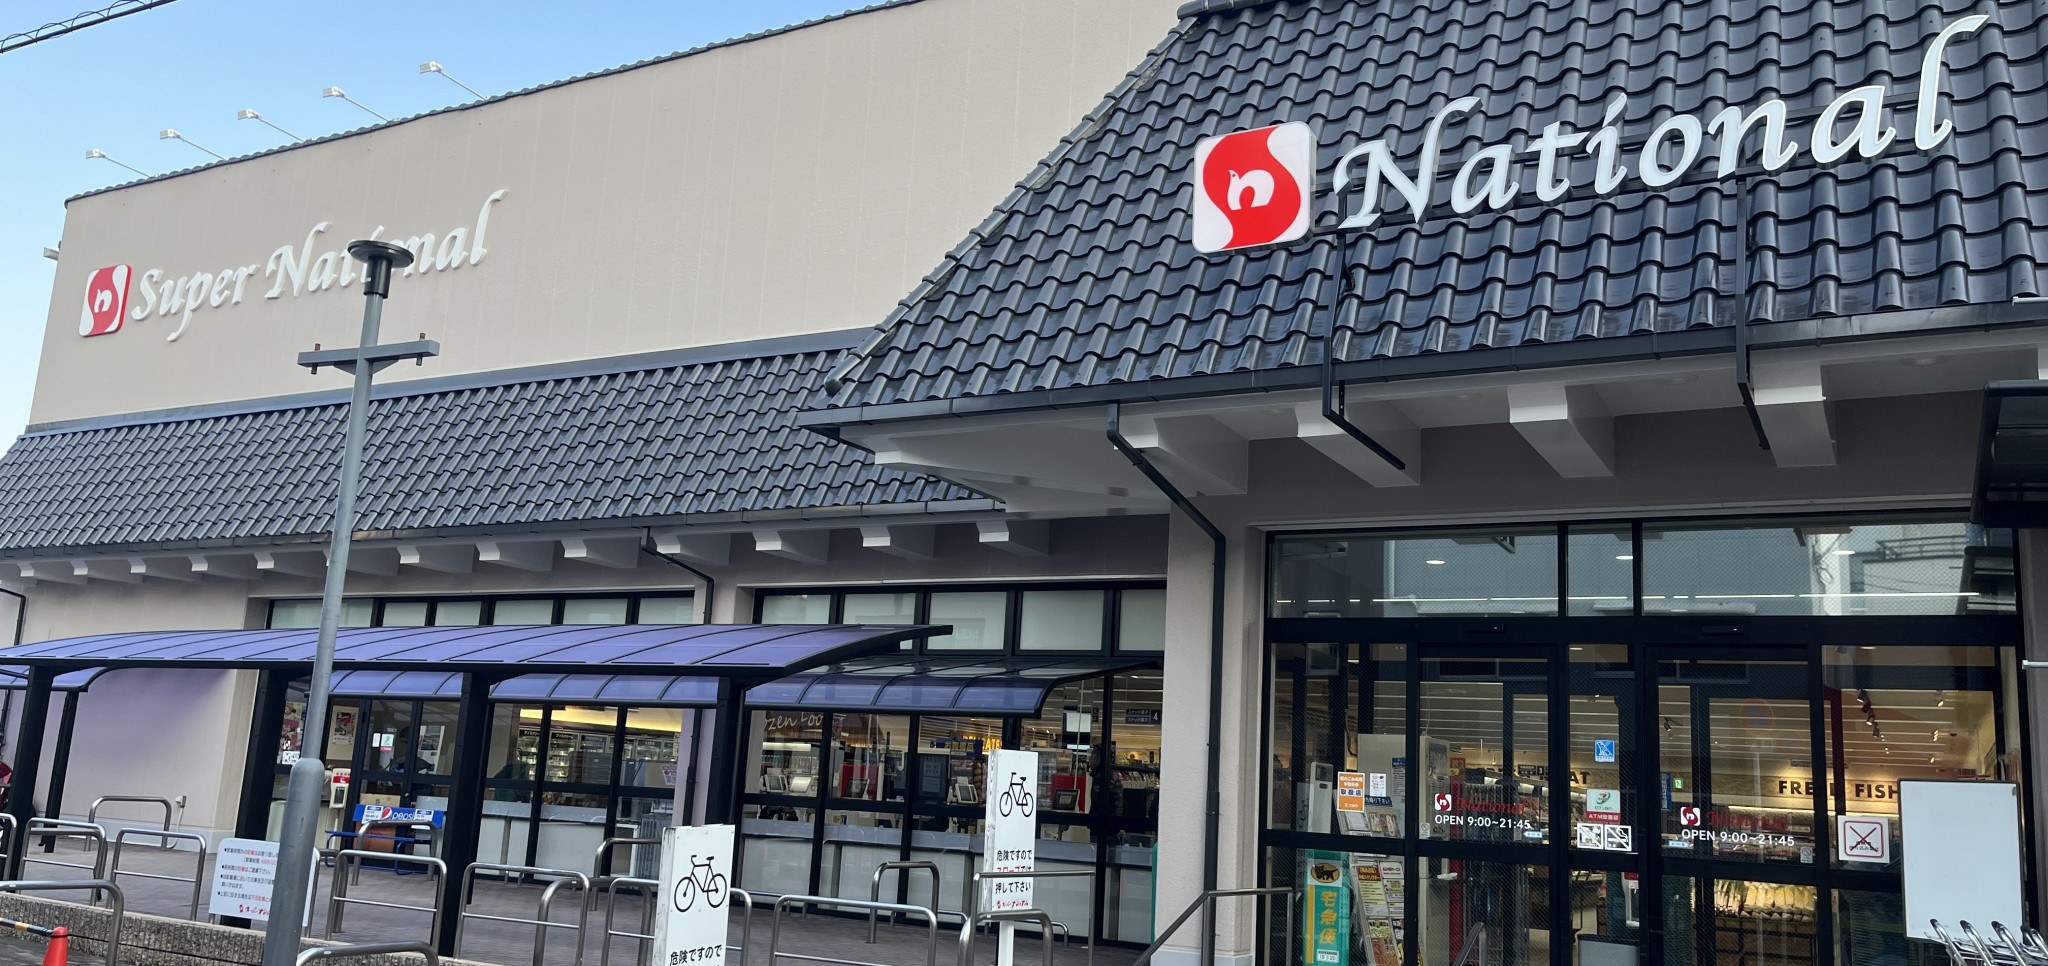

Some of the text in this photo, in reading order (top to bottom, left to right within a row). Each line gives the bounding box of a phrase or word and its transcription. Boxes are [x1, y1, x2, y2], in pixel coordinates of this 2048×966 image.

[1334, 14, 1988, 230] National
[131, 265, 259, 342] Super
[1153, 712, 1158, 721] 4
[1435, 815, 1531, 829] OPEN 9:00~21:45
[1681, 829, 1795, 847] OPEN 9:00~21:45
[997, 849, 1032, 861] 危険ですので
[995, 881, 1031, 894] 押して下さい
[1321, 890, 1338, 945] 宅急便
[669, 944, 722, 966] 危険ですので
